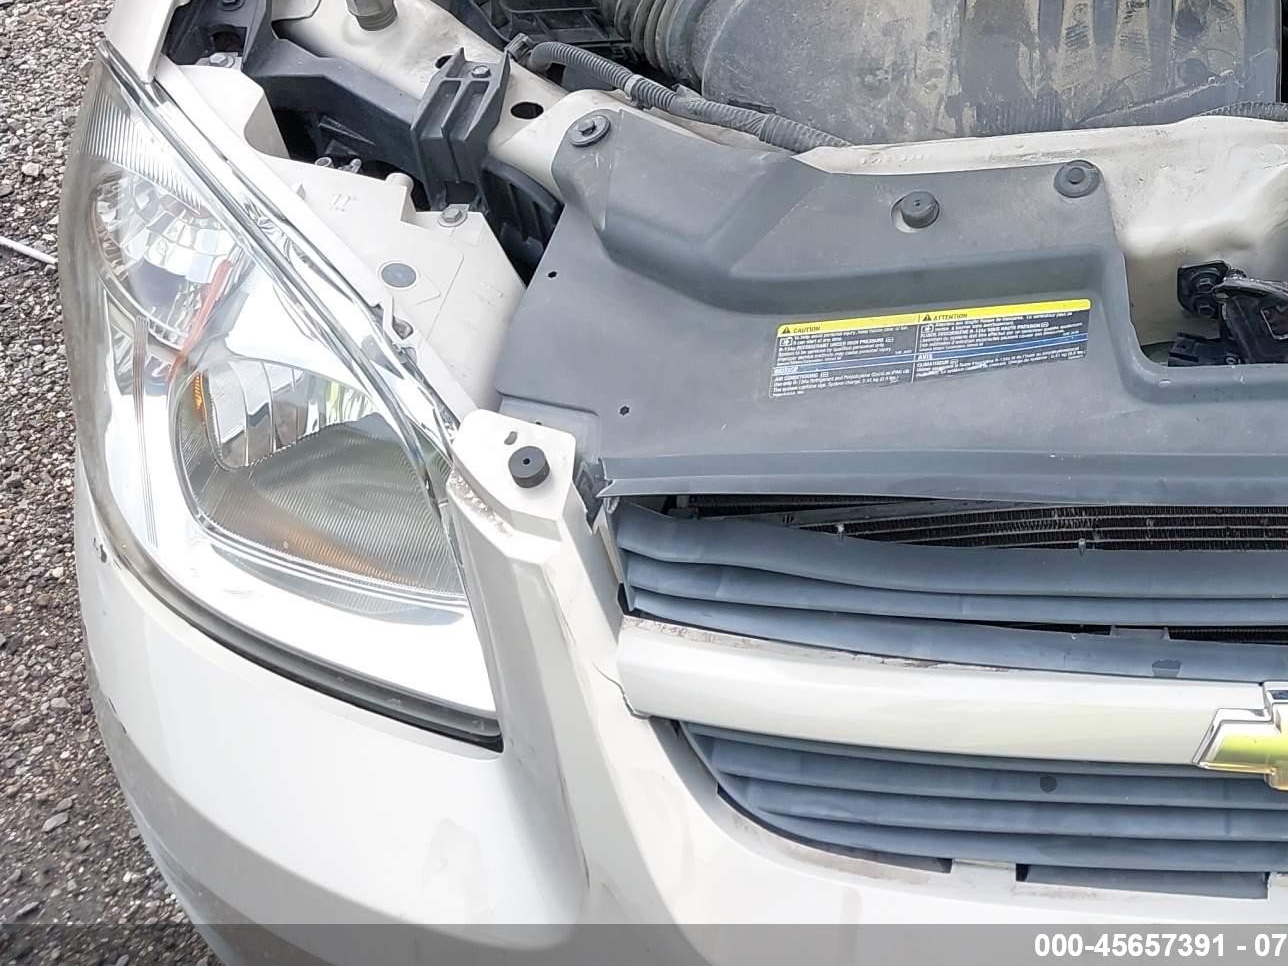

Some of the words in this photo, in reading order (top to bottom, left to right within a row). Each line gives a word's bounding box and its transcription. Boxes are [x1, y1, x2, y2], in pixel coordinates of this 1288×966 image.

[933, 313, 968, 321] ATTENTION
[793, 326, 821, 334] CAUTION
[918, 353, 933, 361] AVIS
